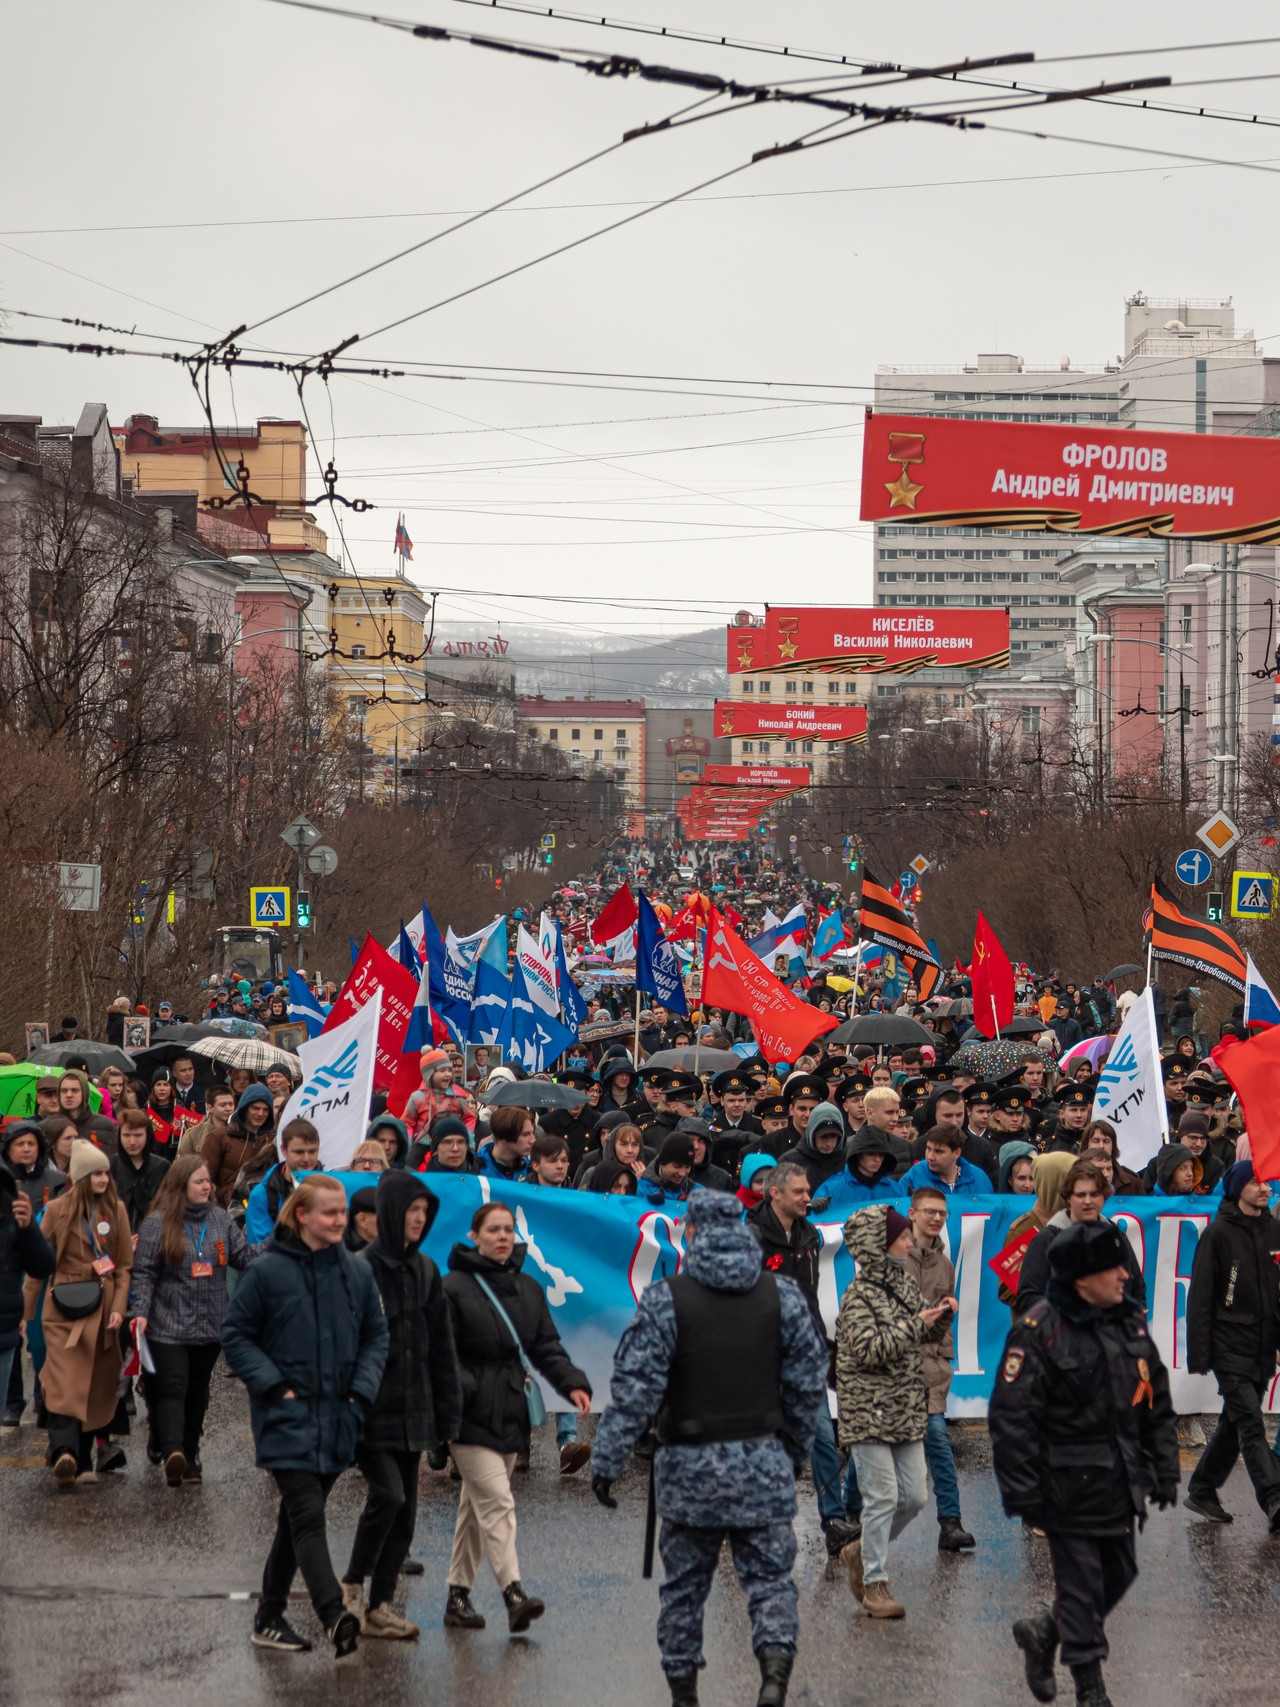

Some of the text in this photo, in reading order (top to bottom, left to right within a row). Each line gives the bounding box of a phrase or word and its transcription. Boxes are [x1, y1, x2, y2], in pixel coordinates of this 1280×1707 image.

[1062, 441, 1167, 472] ФРОЛОВ
[991, 469, 1235, 507] Андрей Дмитриевич
[872, 614, 935, 632] КИСЕЛЁВ
[833, 633, 973, 650] Василий Николаевич
[786, 709, 815, 720] БОКИЙ
[758, 718, 842, 732] Николай Андреевич
[737, 776, 791, 785] Василий Иванович
